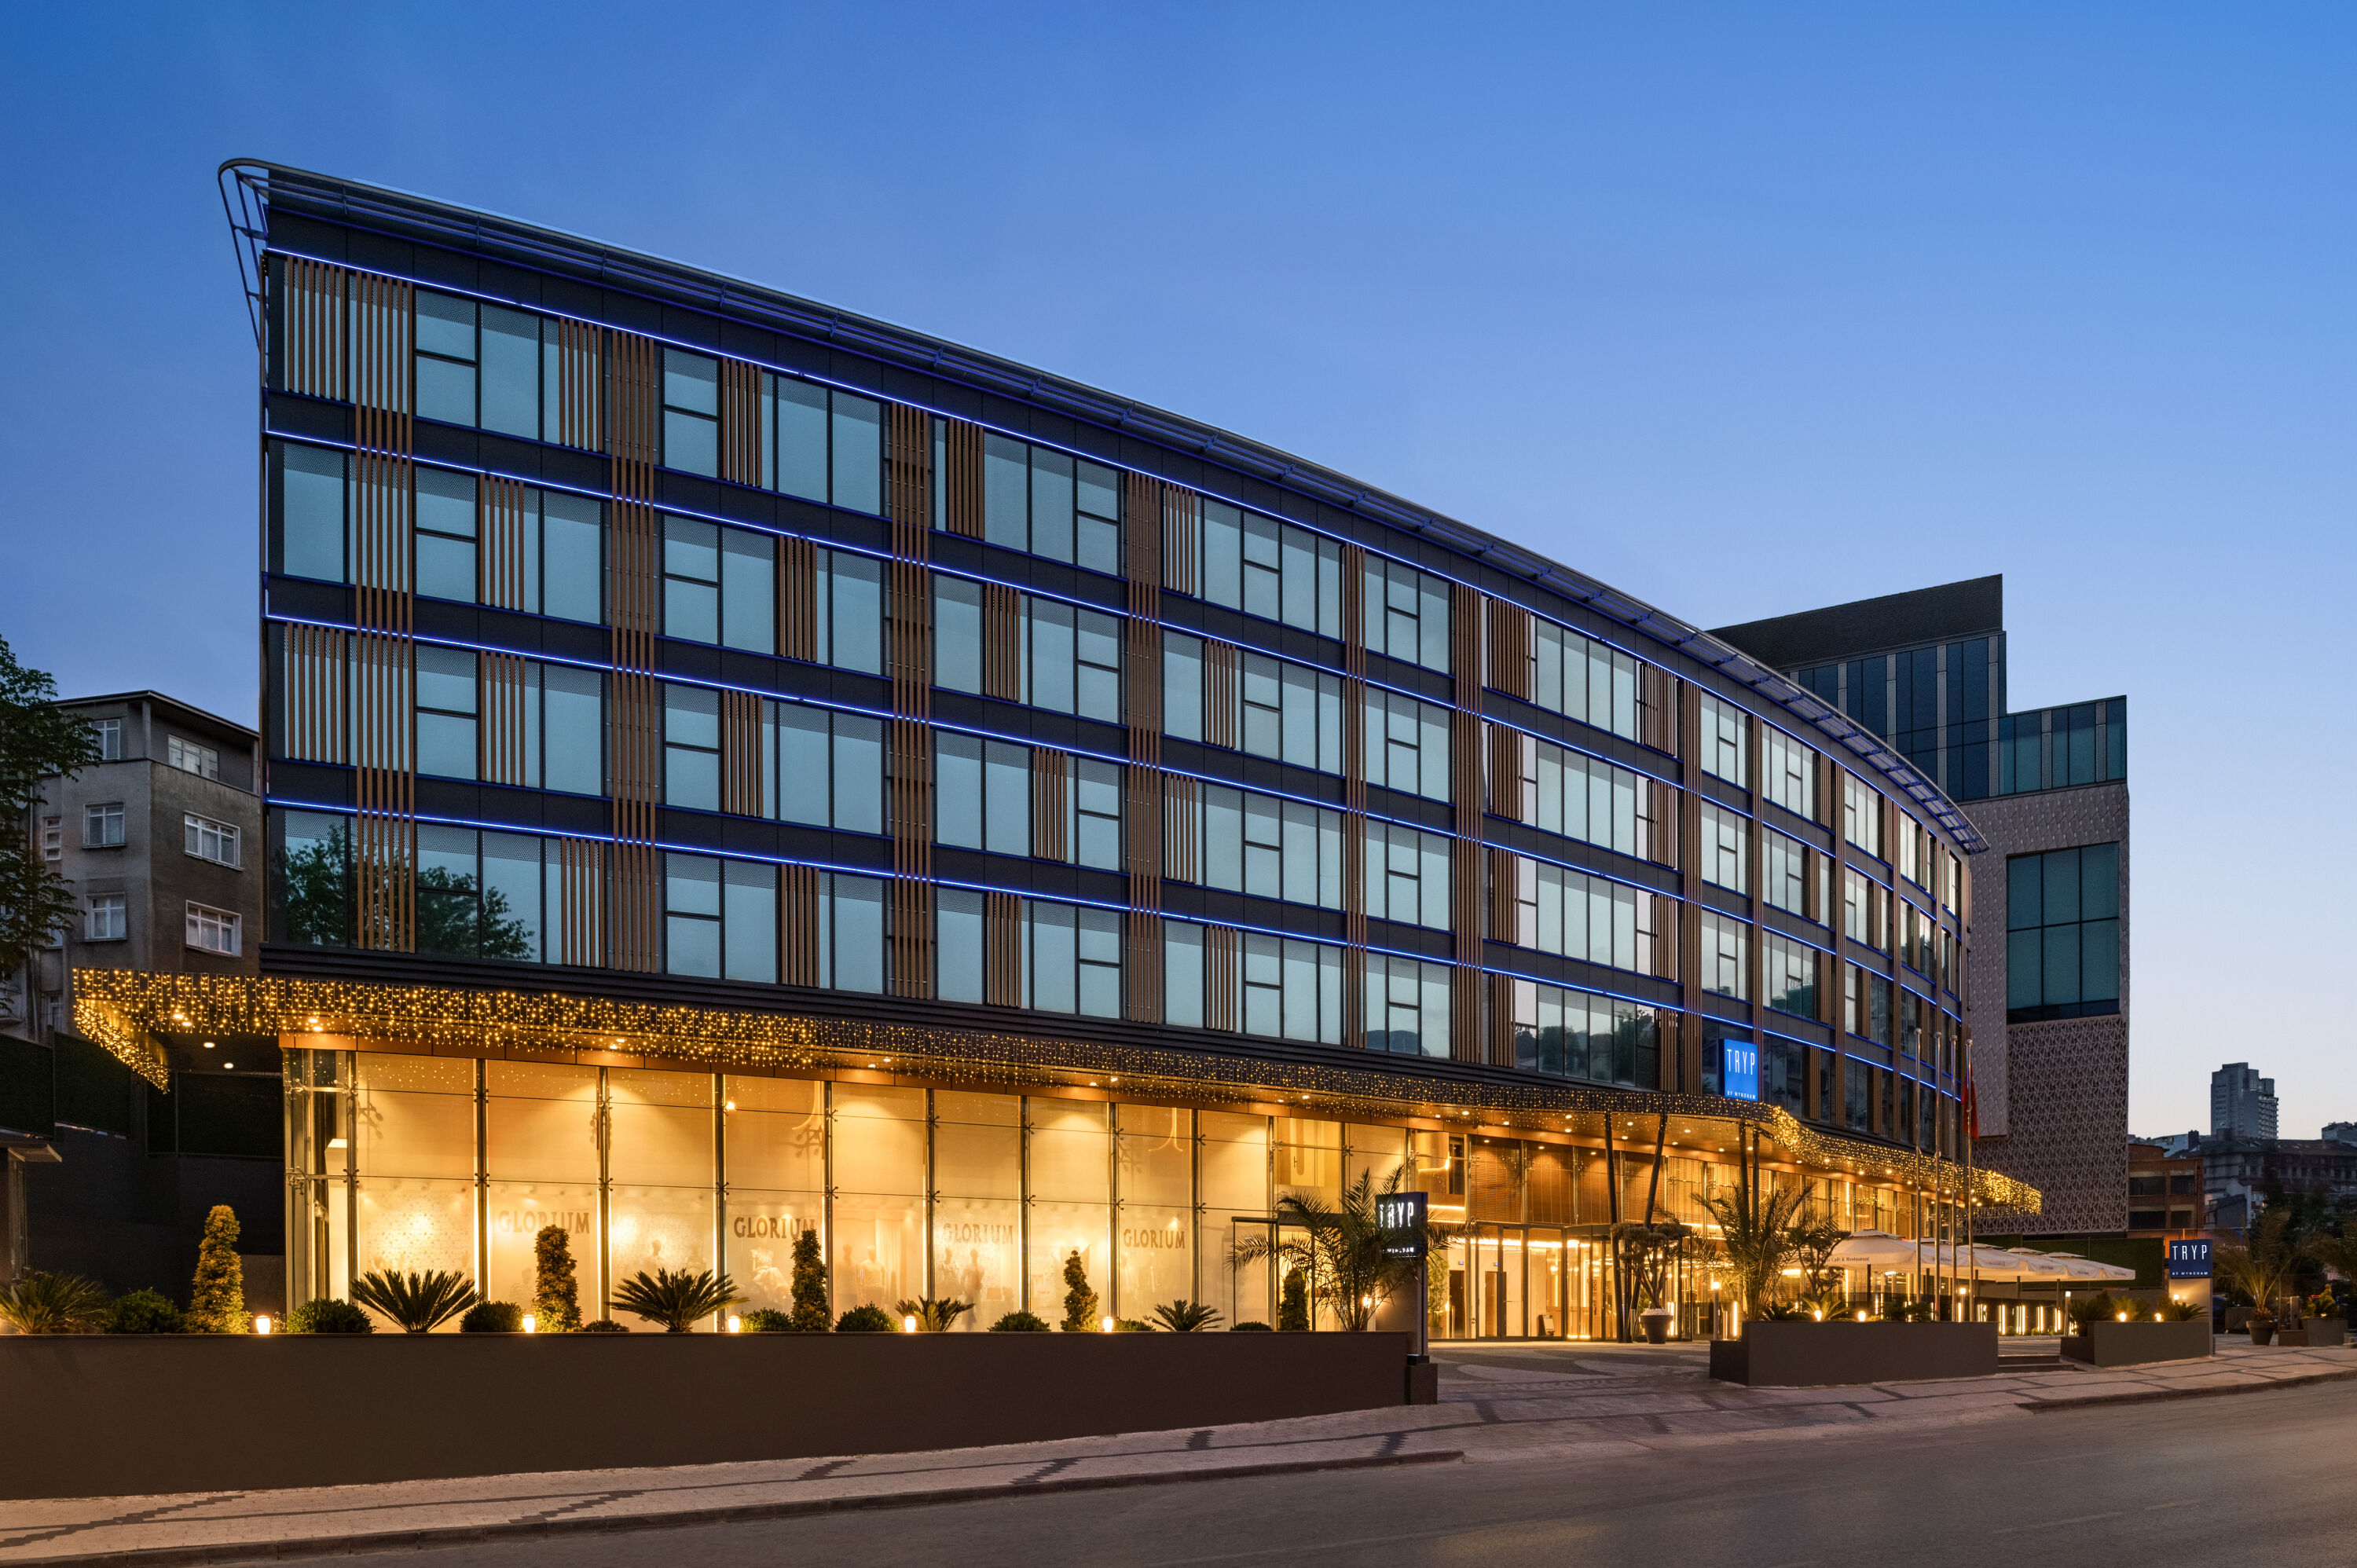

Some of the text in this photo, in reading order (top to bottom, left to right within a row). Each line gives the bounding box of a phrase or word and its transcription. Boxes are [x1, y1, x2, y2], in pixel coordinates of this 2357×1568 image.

[1727, 1049, 1755, 1075] TRYP
[497, 1210, 590, 1234] GLORIUM
[734, 1216, 816, 1239] GLORIUM
[943, 1222, 1014, 1245] GLORIUM
[1124, 1228, 1186, 1250] GLORIUM
[2172, 1244, 2208, 1261] TRYP
